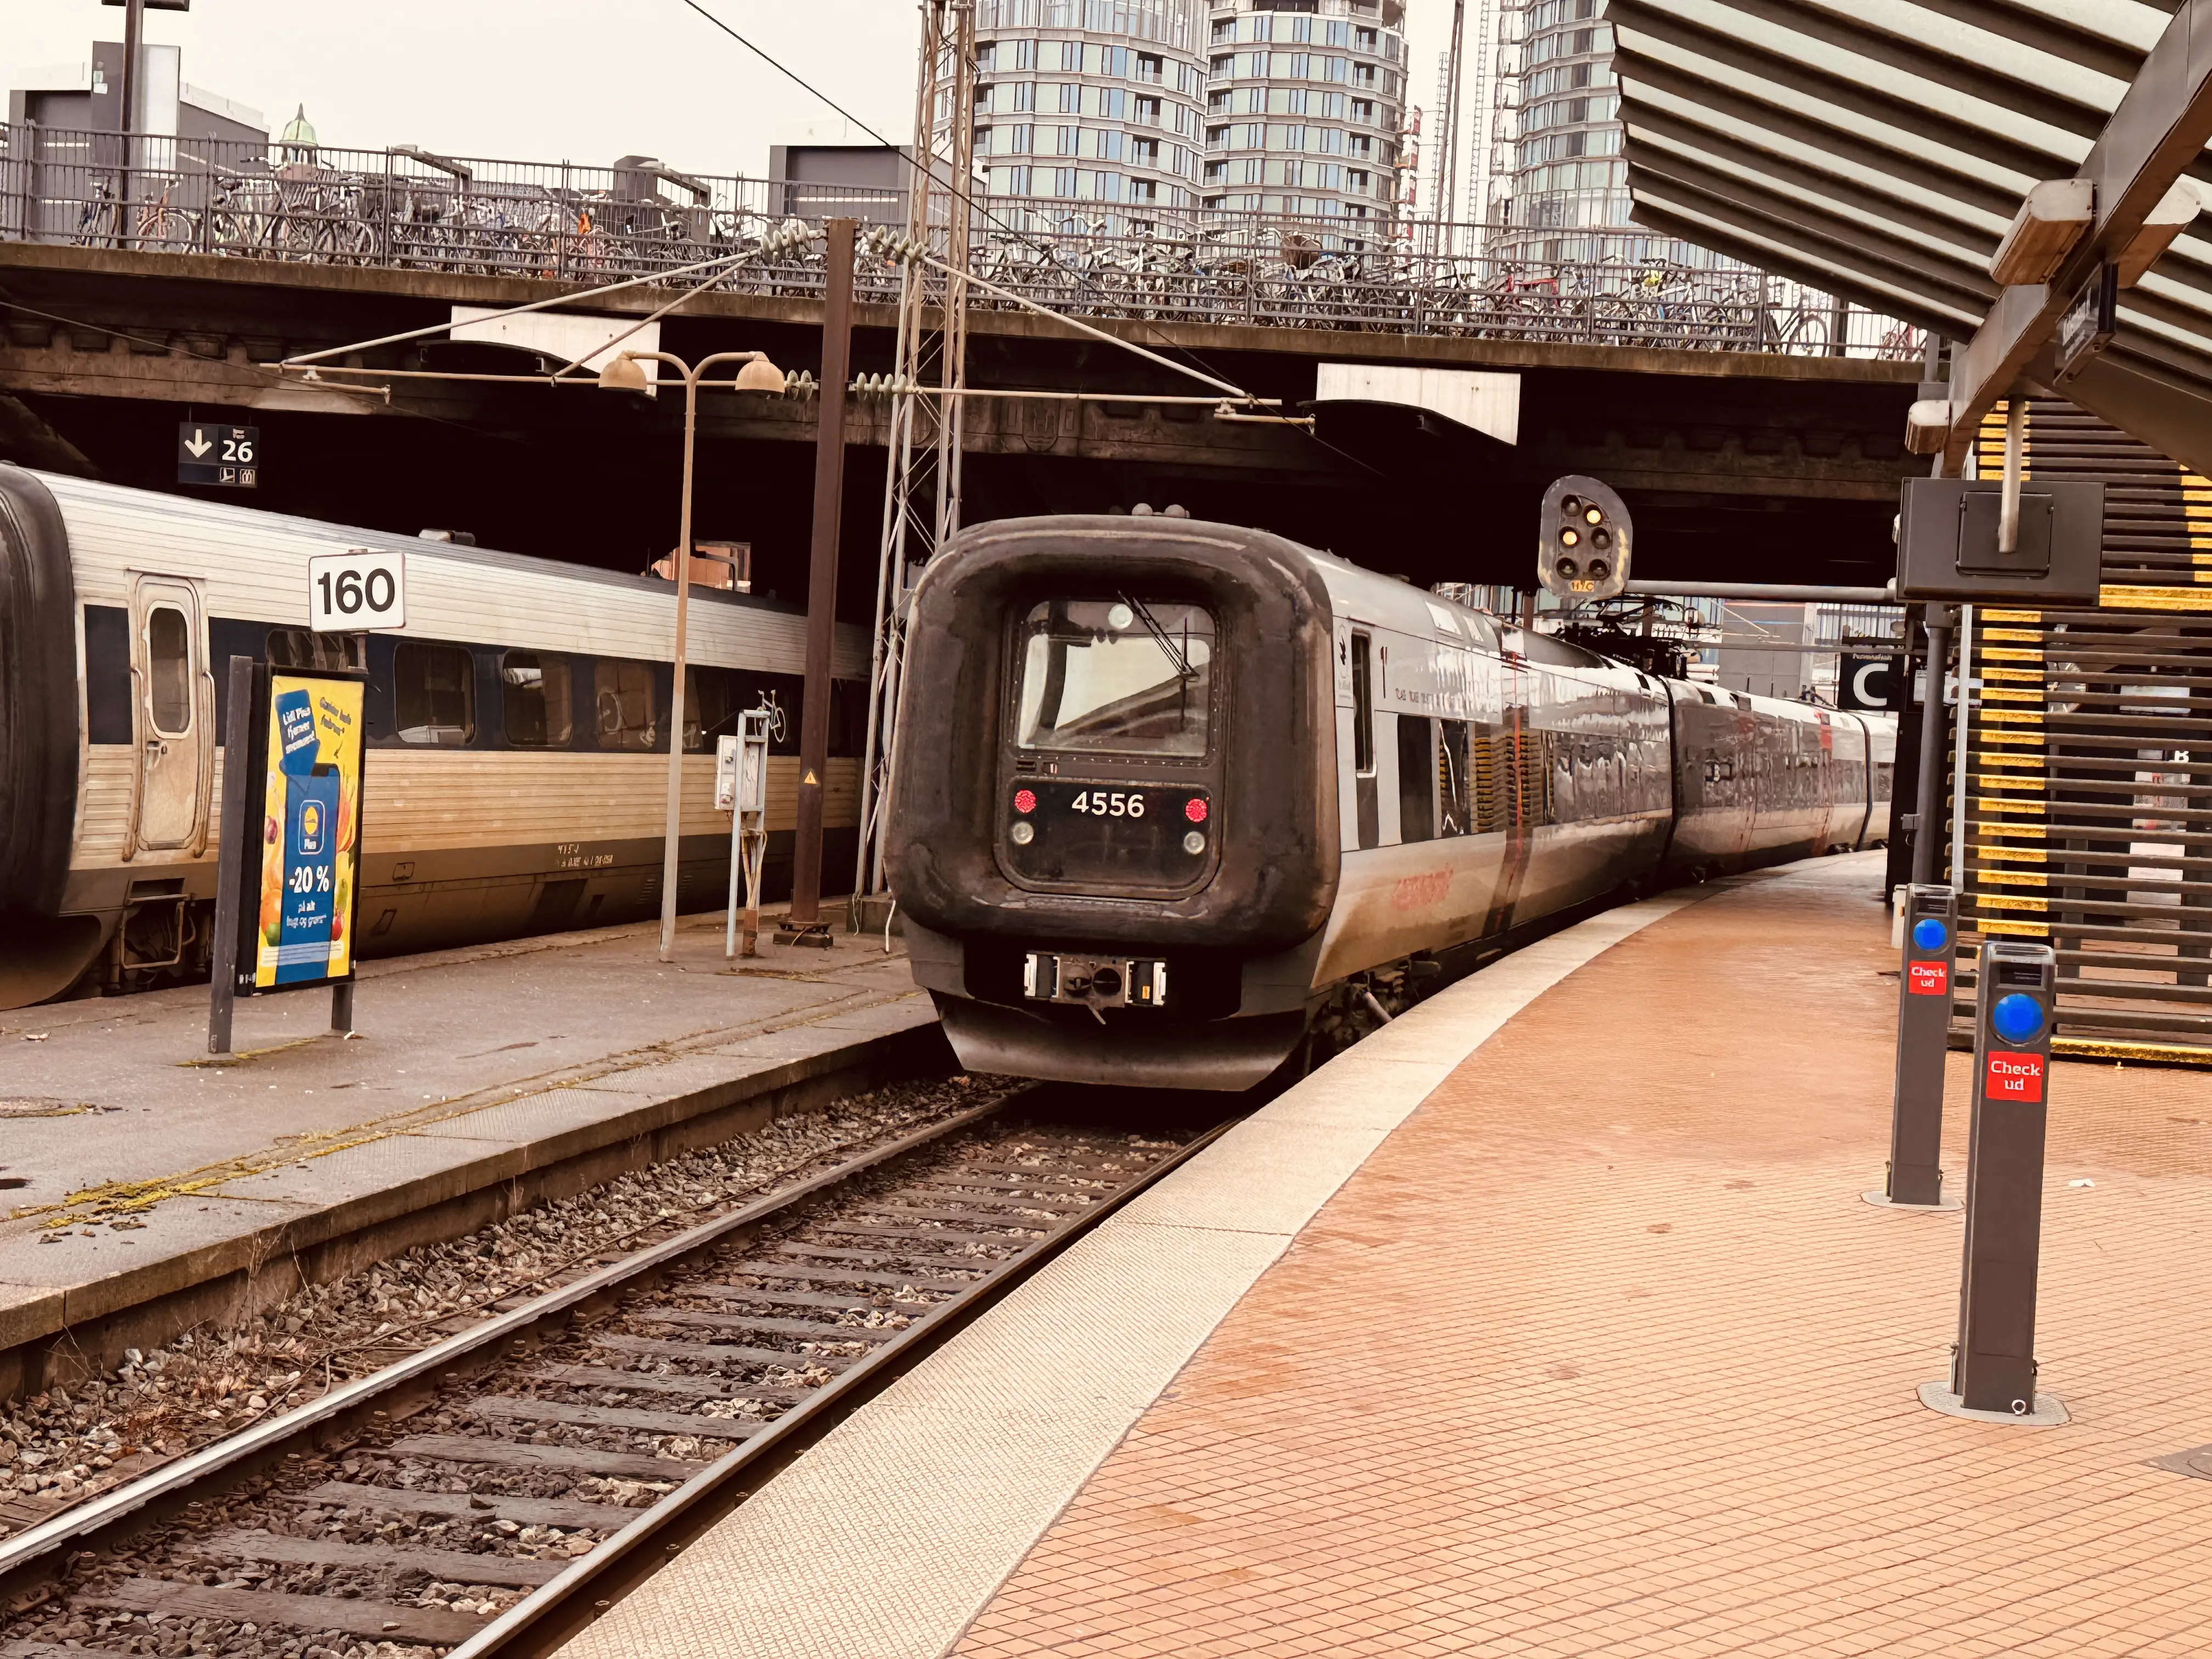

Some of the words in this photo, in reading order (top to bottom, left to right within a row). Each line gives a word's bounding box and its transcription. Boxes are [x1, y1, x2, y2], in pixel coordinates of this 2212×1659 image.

[222, 440, 253, 462] 26
[318, 568, 395, 614] 160
[1853, 663, 1889, 707] C
[1071, 791, 1145, 818] 4556
[289, 866, 313, 893] -20
[317, 865, 330, 893] %
[1911, 966, 1946, 977] Check
[1920, 978, 1935, 988] ud
[1991, 1060, 2041, 1076] Check
[2004, 1077, 2024, 1091] ud
